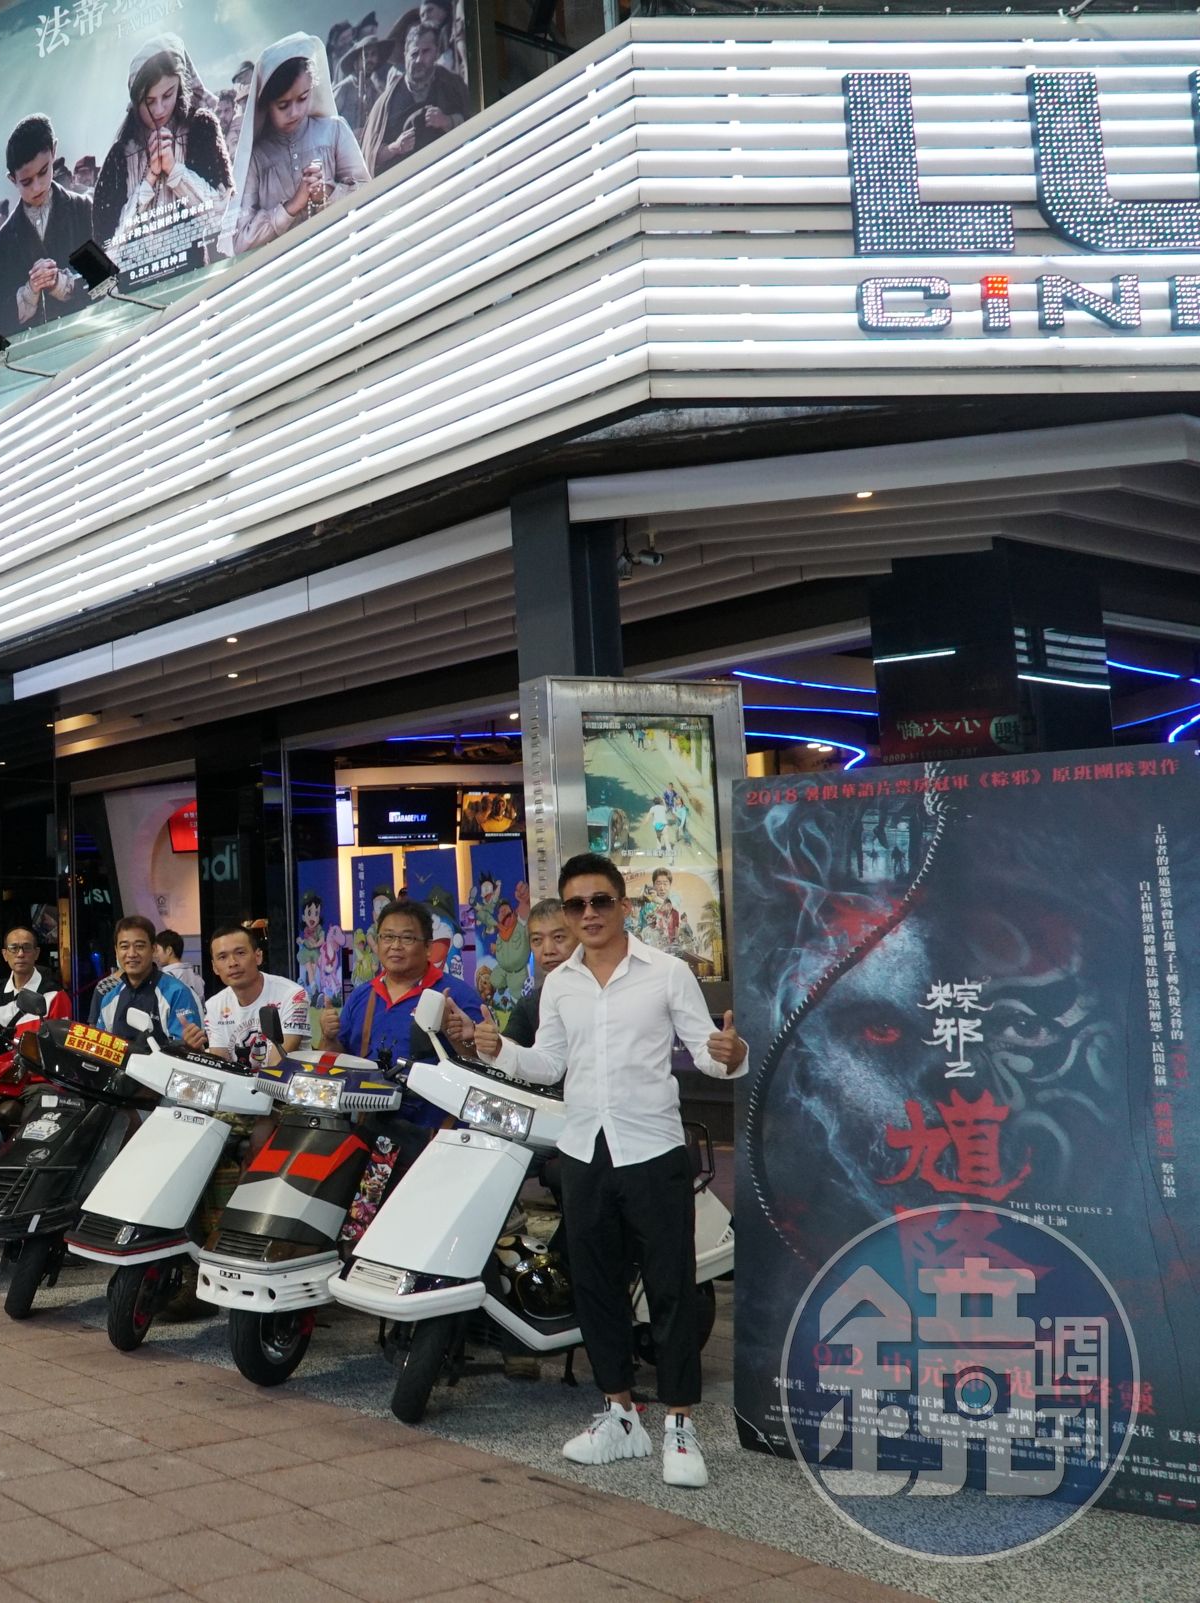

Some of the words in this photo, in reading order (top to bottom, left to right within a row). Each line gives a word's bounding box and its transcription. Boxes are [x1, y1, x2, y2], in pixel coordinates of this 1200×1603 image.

[842, 71, 1200, 255] LU
[129, 267, 150, 280] 9.25
[746, 790, 798, 806] 2018
[1052, 758, 1181, 783] 原班團隊製作
[186, 1053, 223, 1069] HONDA
[487, 1068, 532, 1088] HONDA
[1008, 1200, 1031, 1210] THE
[1034, 1202, 1063, 1213] ROPE
[1066, 1204, 1103, 1215] CURSE
[1106, 1207, 1114, 1216] 2
